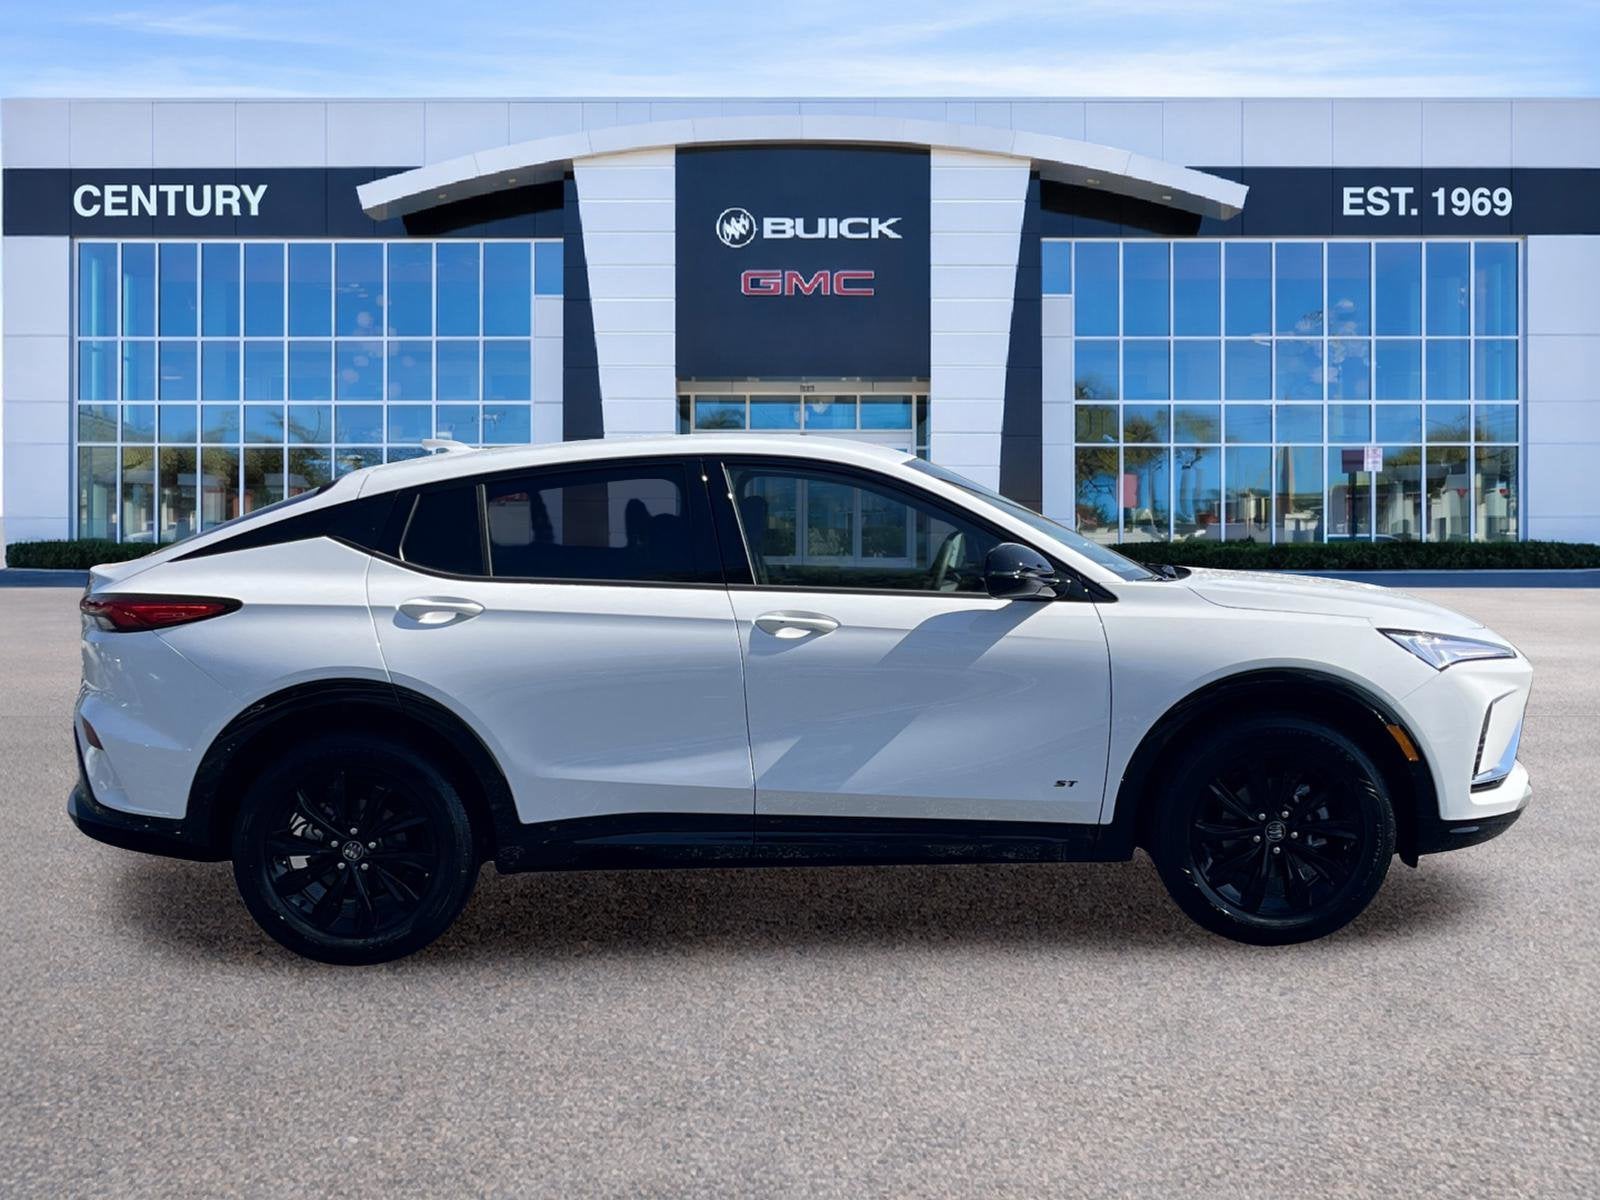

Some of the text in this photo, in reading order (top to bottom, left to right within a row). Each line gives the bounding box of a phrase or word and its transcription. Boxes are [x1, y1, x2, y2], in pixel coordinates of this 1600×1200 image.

[73, 184, 268, 217] CENTURY
[1342, 186, 1513, 217] EST. 1969
[762, 217, 903, 239] BUICK
[741, 269, 875, 296] GMC
[1054, 780, 1078, 788] ST
